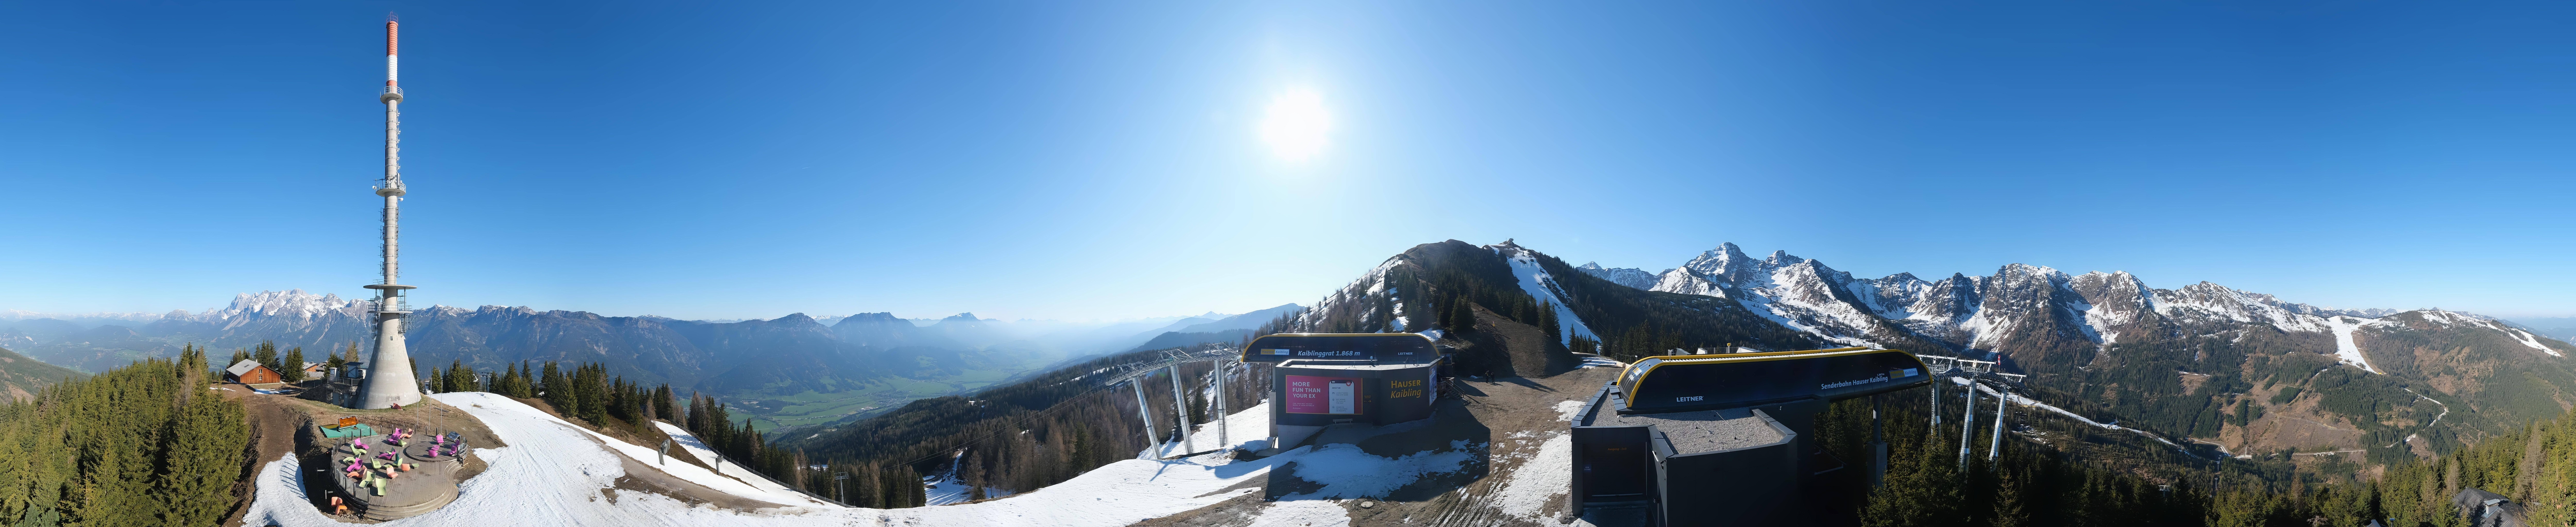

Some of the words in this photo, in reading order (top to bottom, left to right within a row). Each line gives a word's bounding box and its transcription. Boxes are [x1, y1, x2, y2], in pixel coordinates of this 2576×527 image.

[1391, 380, 1421, 388] HAUSER
[1821, 381, 1852, 389] Senderbahn
[1391, 388, 1421, 398] Kaibling
